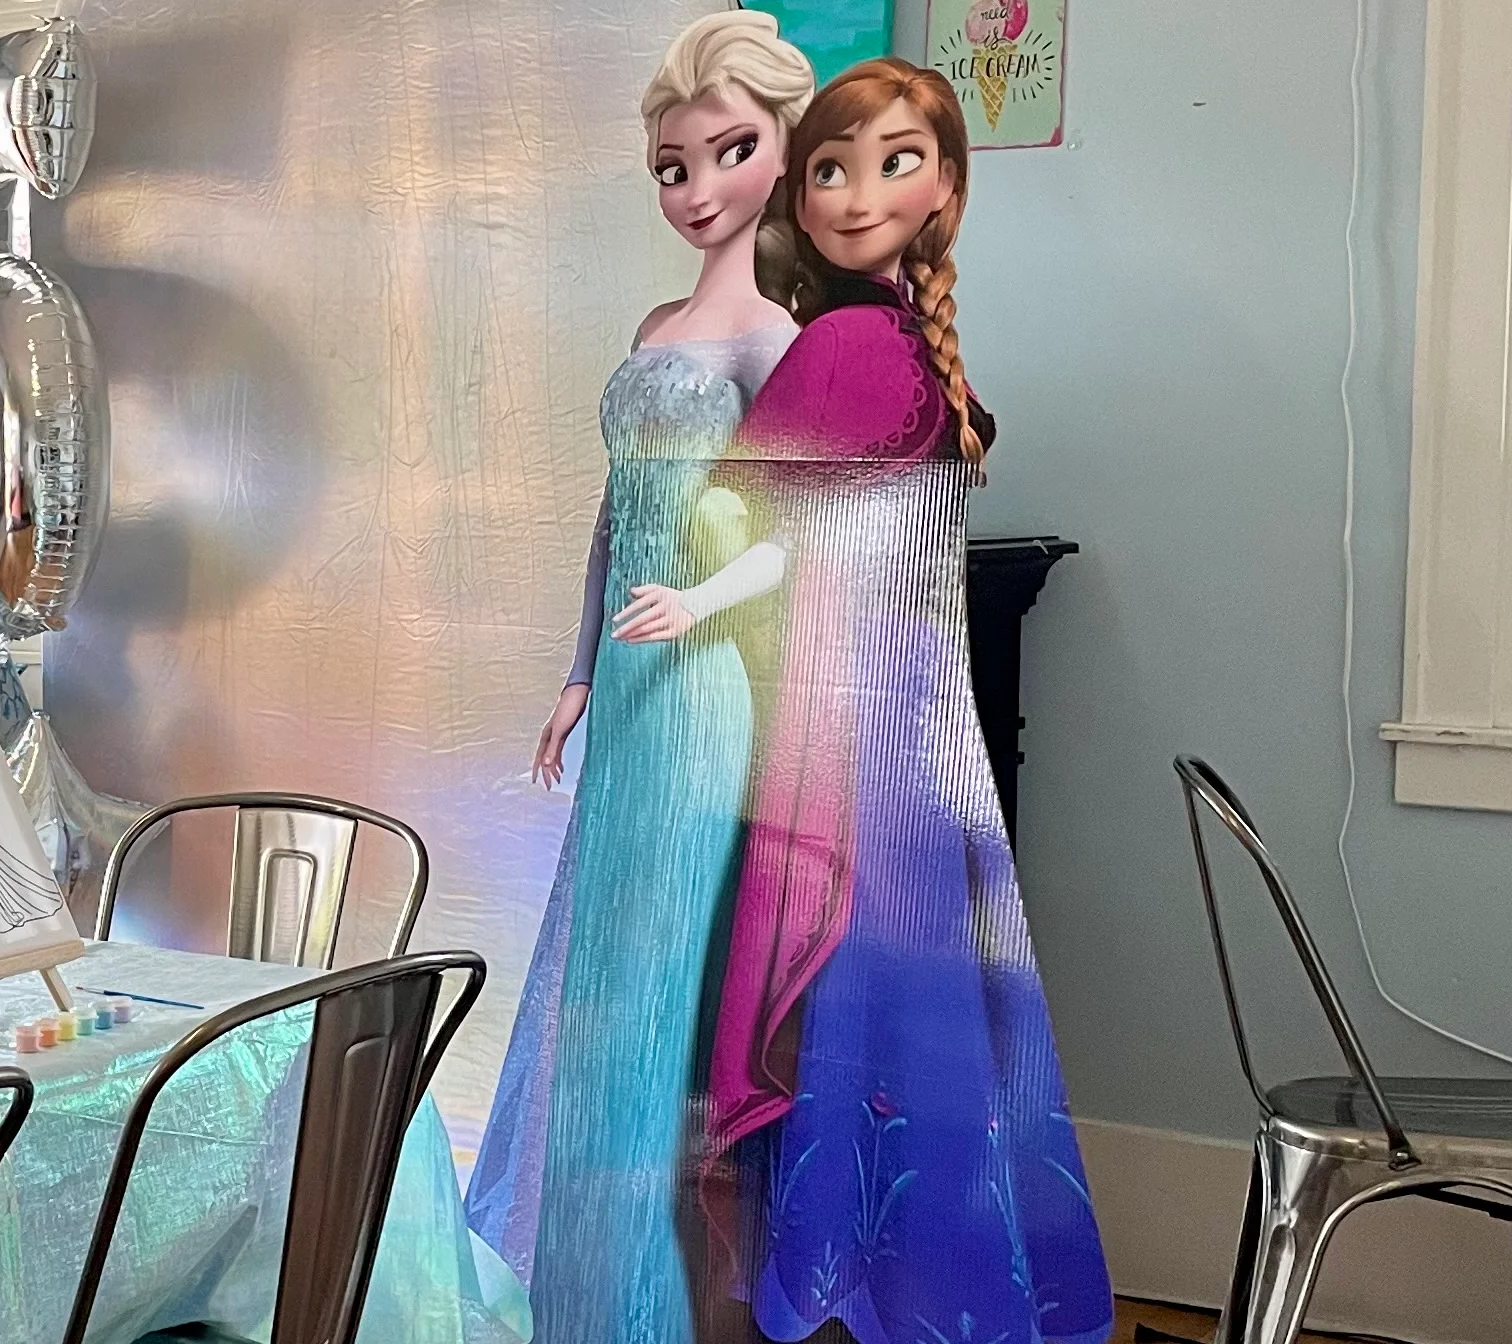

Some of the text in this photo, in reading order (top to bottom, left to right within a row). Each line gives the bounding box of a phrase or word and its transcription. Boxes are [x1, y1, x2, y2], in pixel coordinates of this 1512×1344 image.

[980, 2, 1012, 21] need
[983, 26, 1012, 51] is
[951, 53, 1040, 81] ICE CREAM
